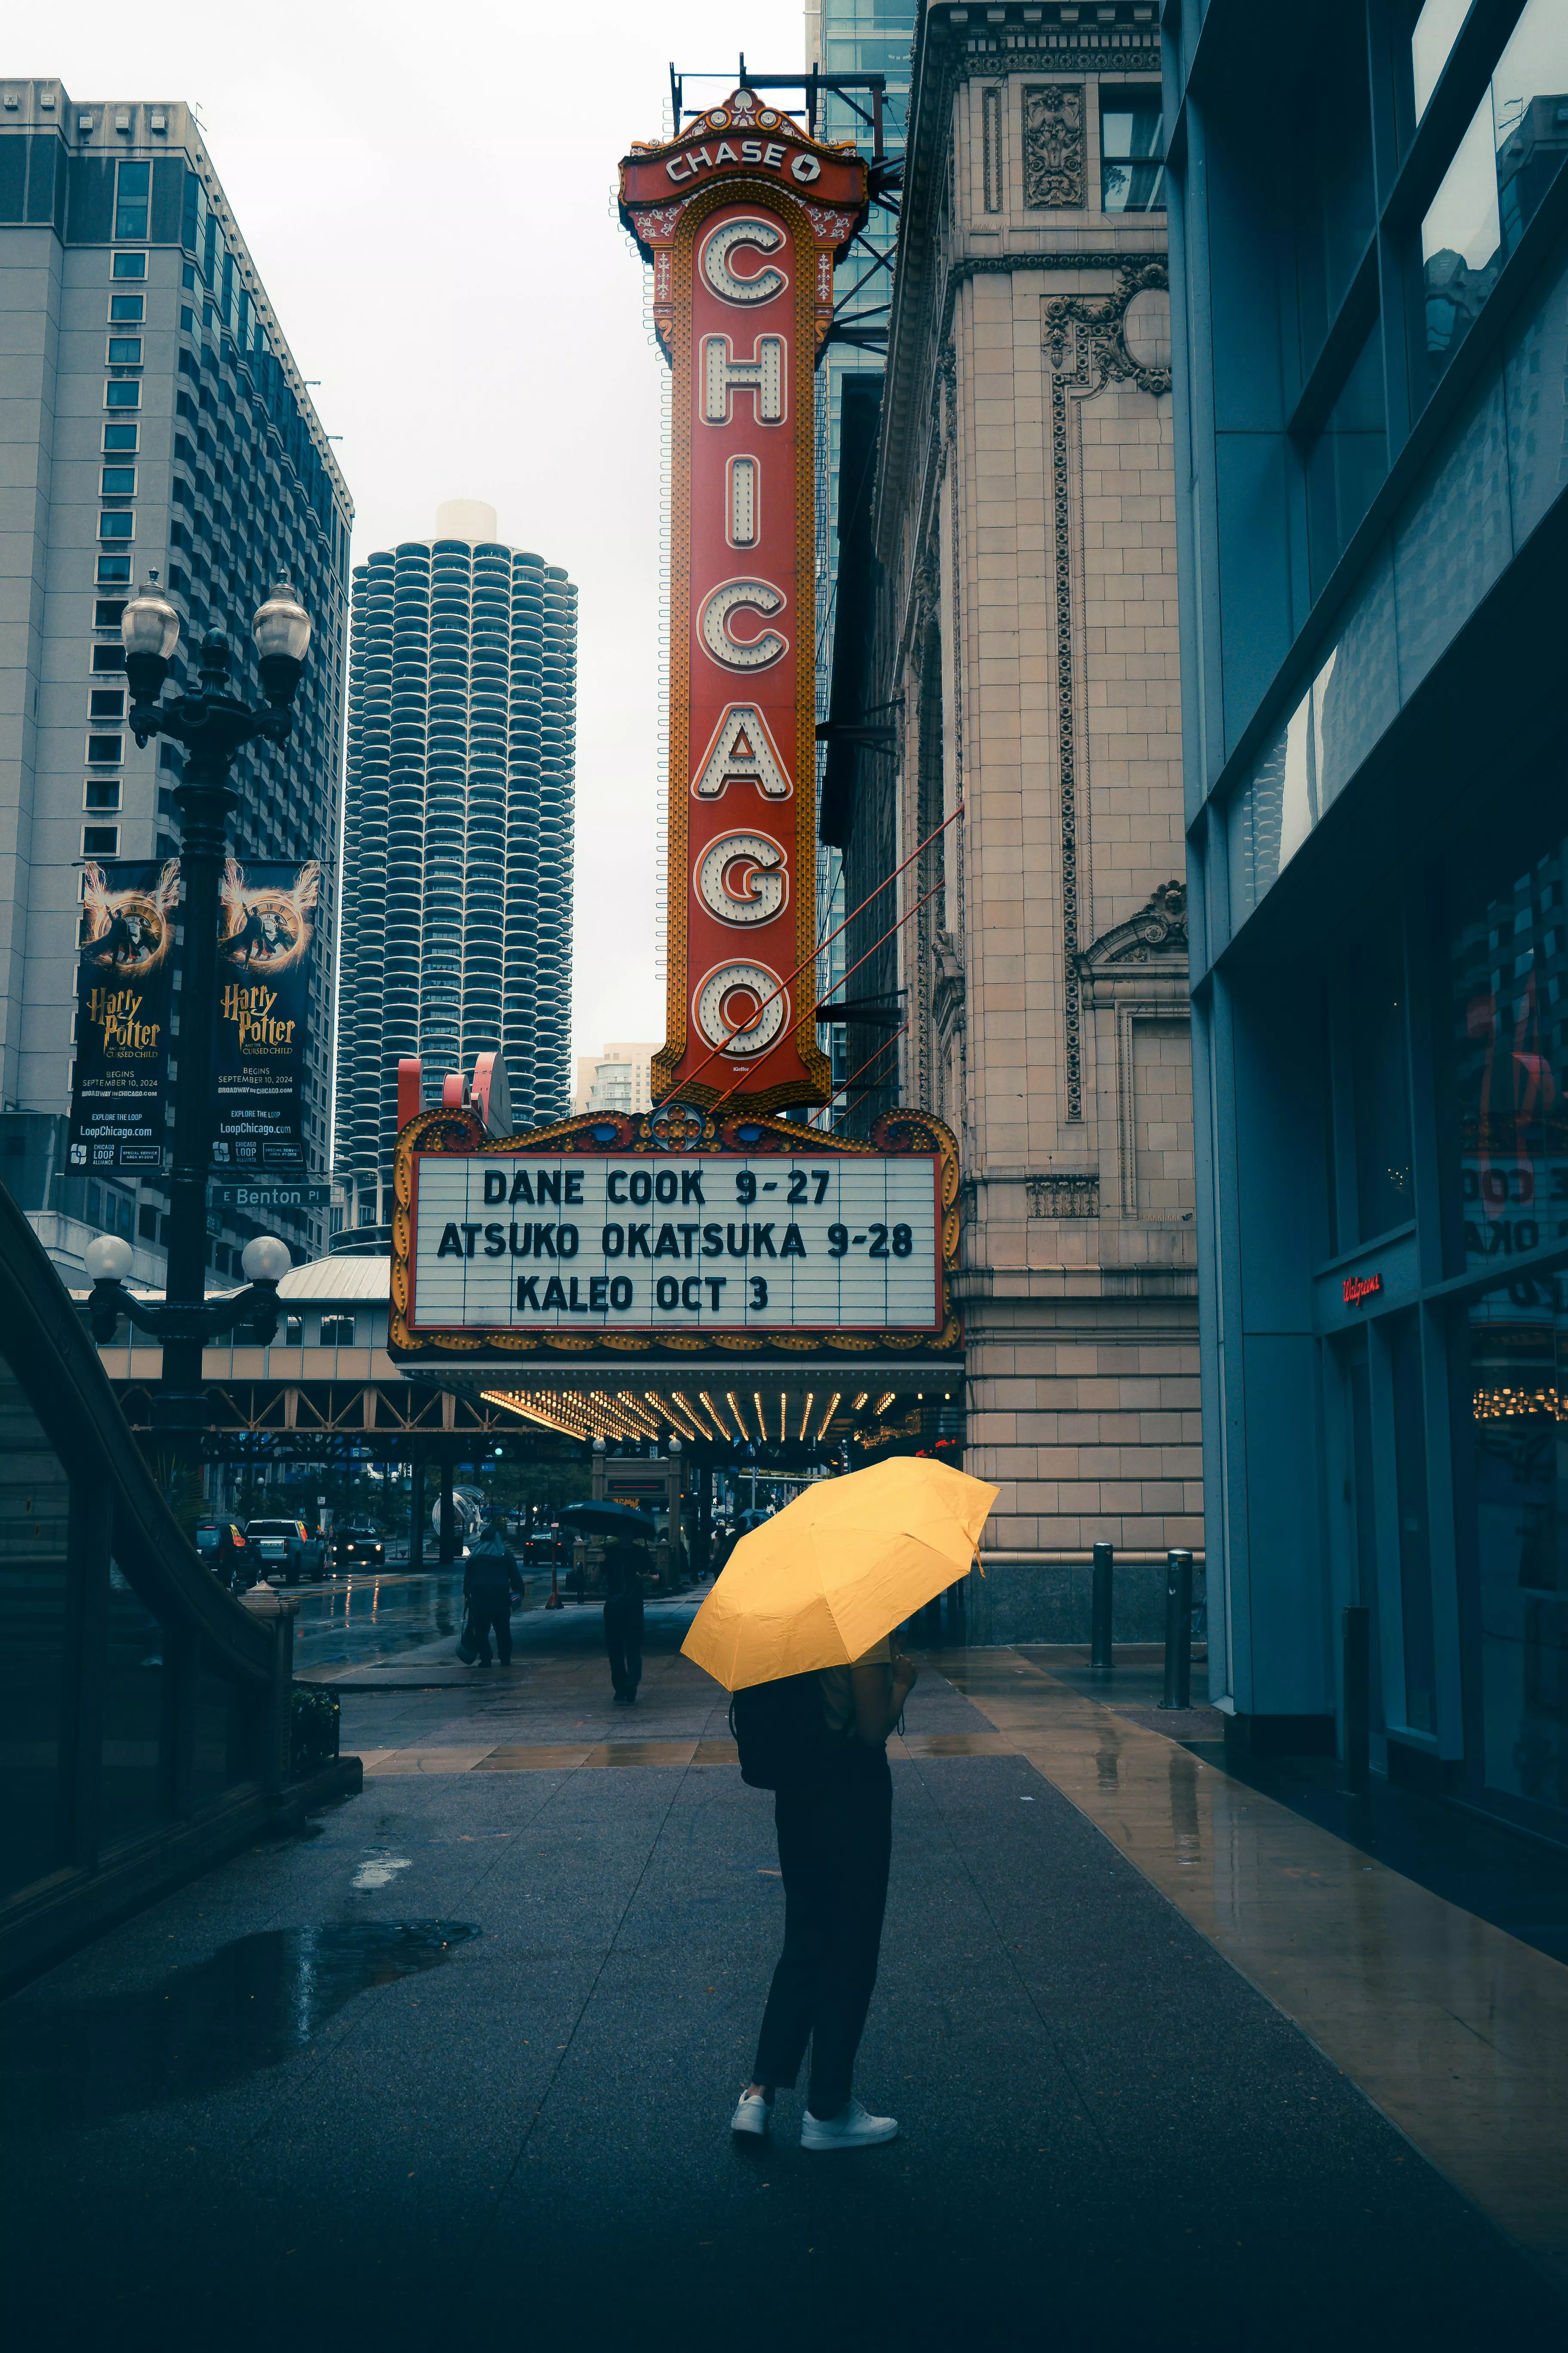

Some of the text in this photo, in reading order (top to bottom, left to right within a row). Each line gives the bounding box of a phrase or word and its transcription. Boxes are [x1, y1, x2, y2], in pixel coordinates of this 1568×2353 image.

[666, 141, 787, 182] CHASE
[690, 215, 793, 1061] CHICAGO
[86, 987, 143, 1025] Harry
[221, 984, 278, 1021] Harry
[104, 1015, 160, 1056] Potter
[239, 1011, 295, 1051] Potter
[80, 1126, 152, 1138] LoopChicago.com
[221, 1123, 291, 1135] LoopChicago.com
[94, 1150, 114, 1159] LOOP
[236, 1148, 256, 1156] LOOP
[224, 1188, 319, 1204] E Benton Pl
[484, 1169, 584, 1204] DANE
[608, 1169, 706, 1205] COOK
[437, 1222, 913, 1258] ATSUKO OKATSUKA 9-28
[517, 1275, 769, 1311] KALEO OCT 3
[1343, 1273, 1379, 1306] Walgreens
